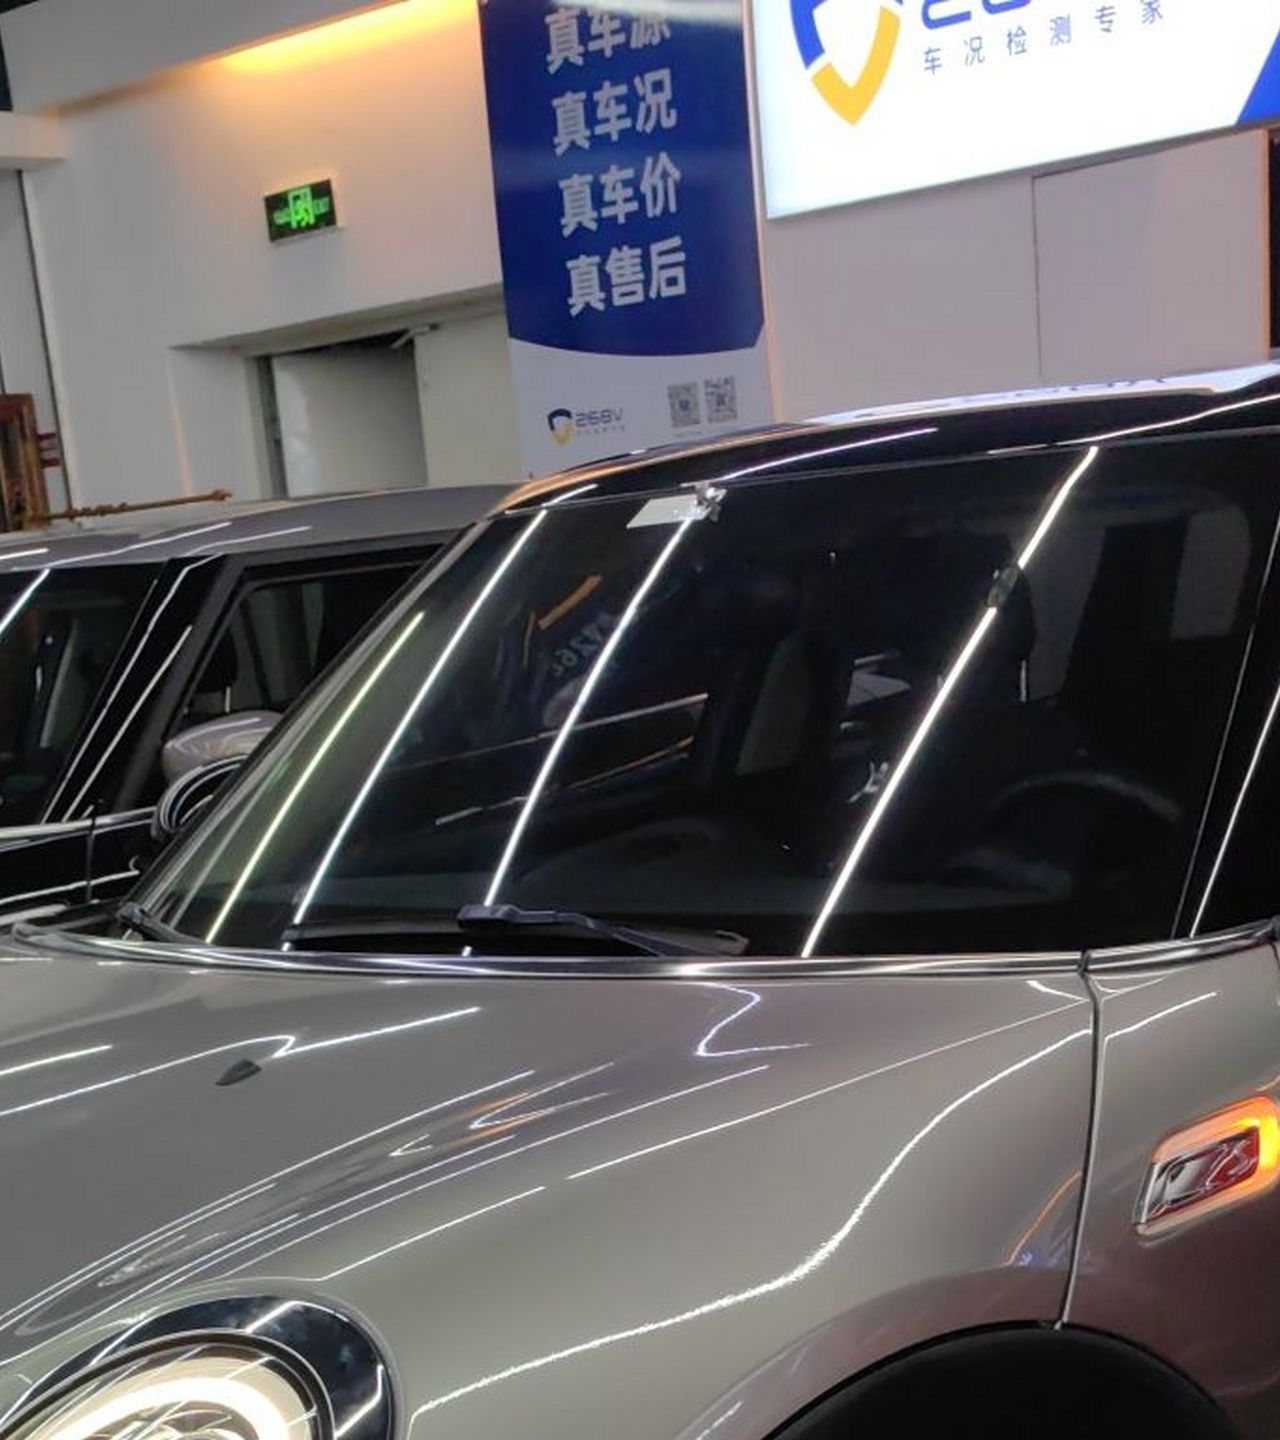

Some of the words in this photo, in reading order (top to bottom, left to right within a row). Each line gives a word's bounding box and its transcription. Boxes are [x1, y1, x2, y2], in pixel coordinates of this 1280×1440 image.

[552, 68, 677, 157] 真车况
[558, 151, 681, 238] 真车价
[566, 235, 686, 317] 真售后
